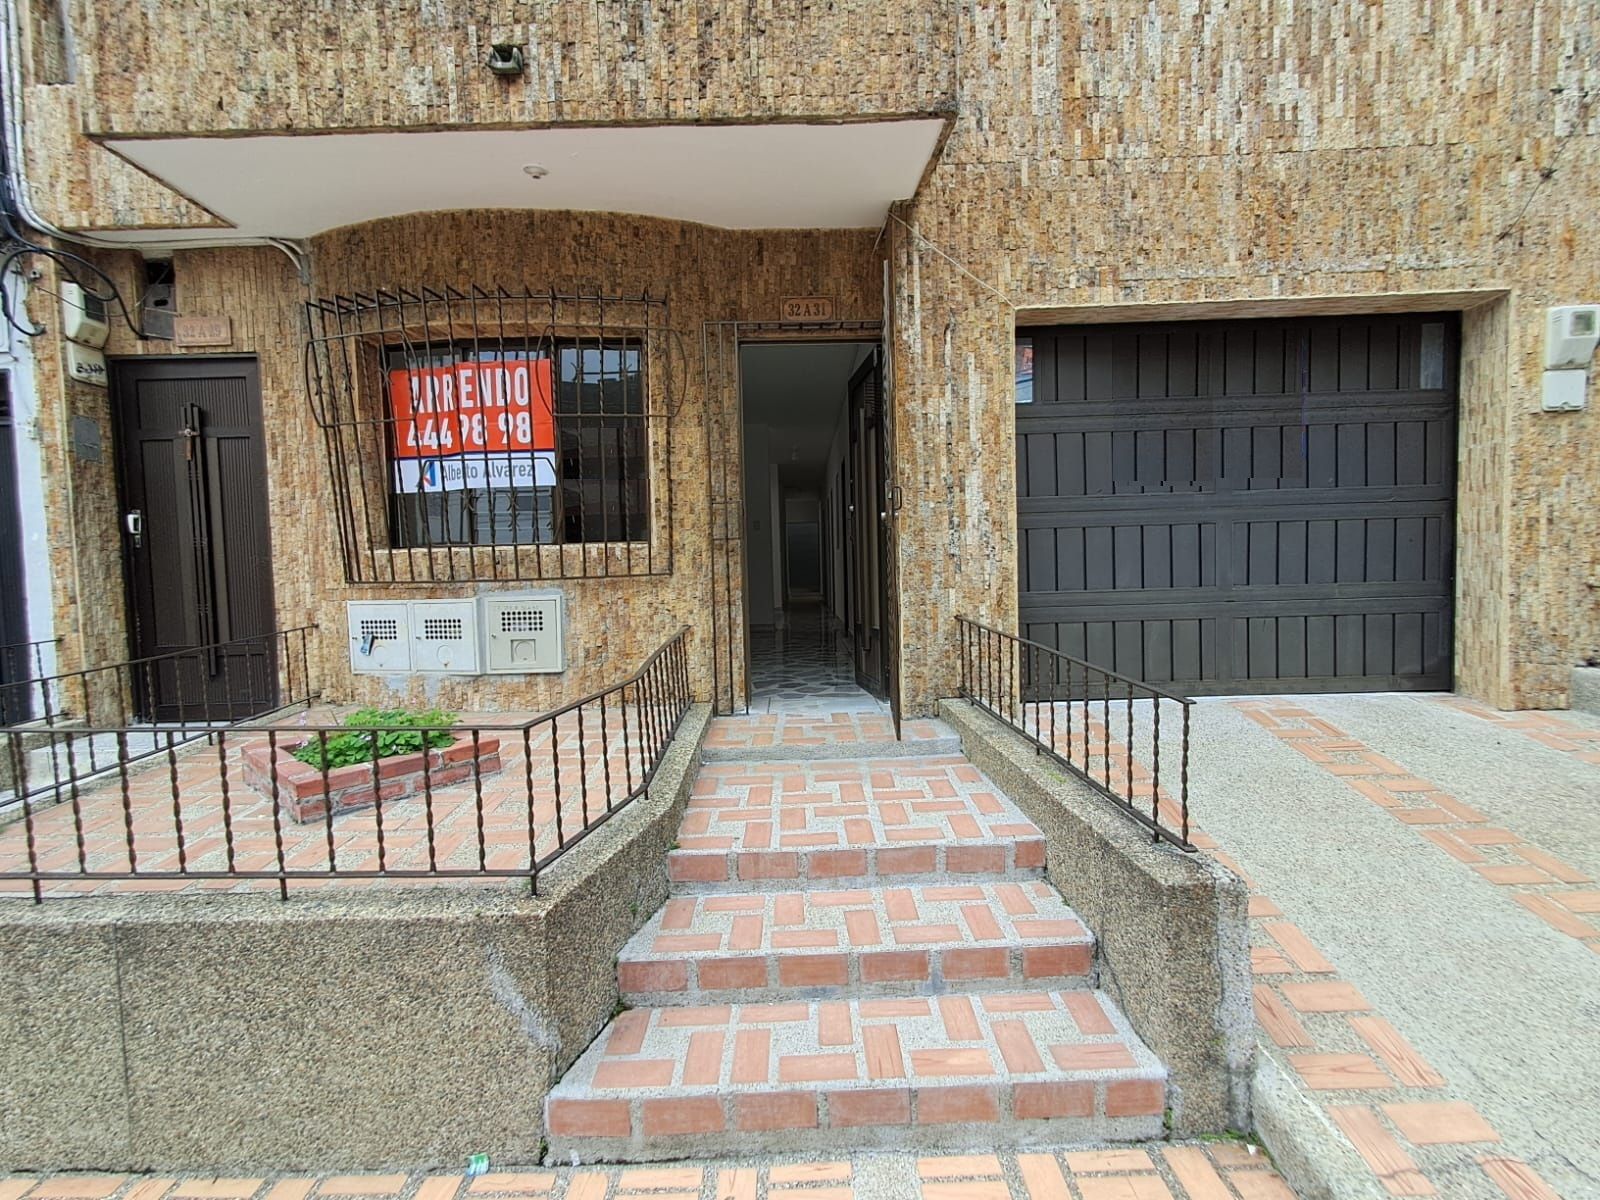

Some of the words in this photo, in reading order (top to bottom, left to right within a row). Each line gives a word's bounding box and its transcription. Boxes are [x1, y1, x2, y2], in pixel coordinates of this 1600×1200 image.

[787, 303, 801, 317] 32
[803, 303, 812, 317] A
[813, 302, 826, 316] 31
[409, 366, 530, 415] ARRENDO
[407, 417, 453, 450] 444
[457, 412, 488, 446] 98
[498, 411, 532, 444] 98
[442, 462, 478, 482] Albeto
[483, 461, 534, 479] Alvarez
